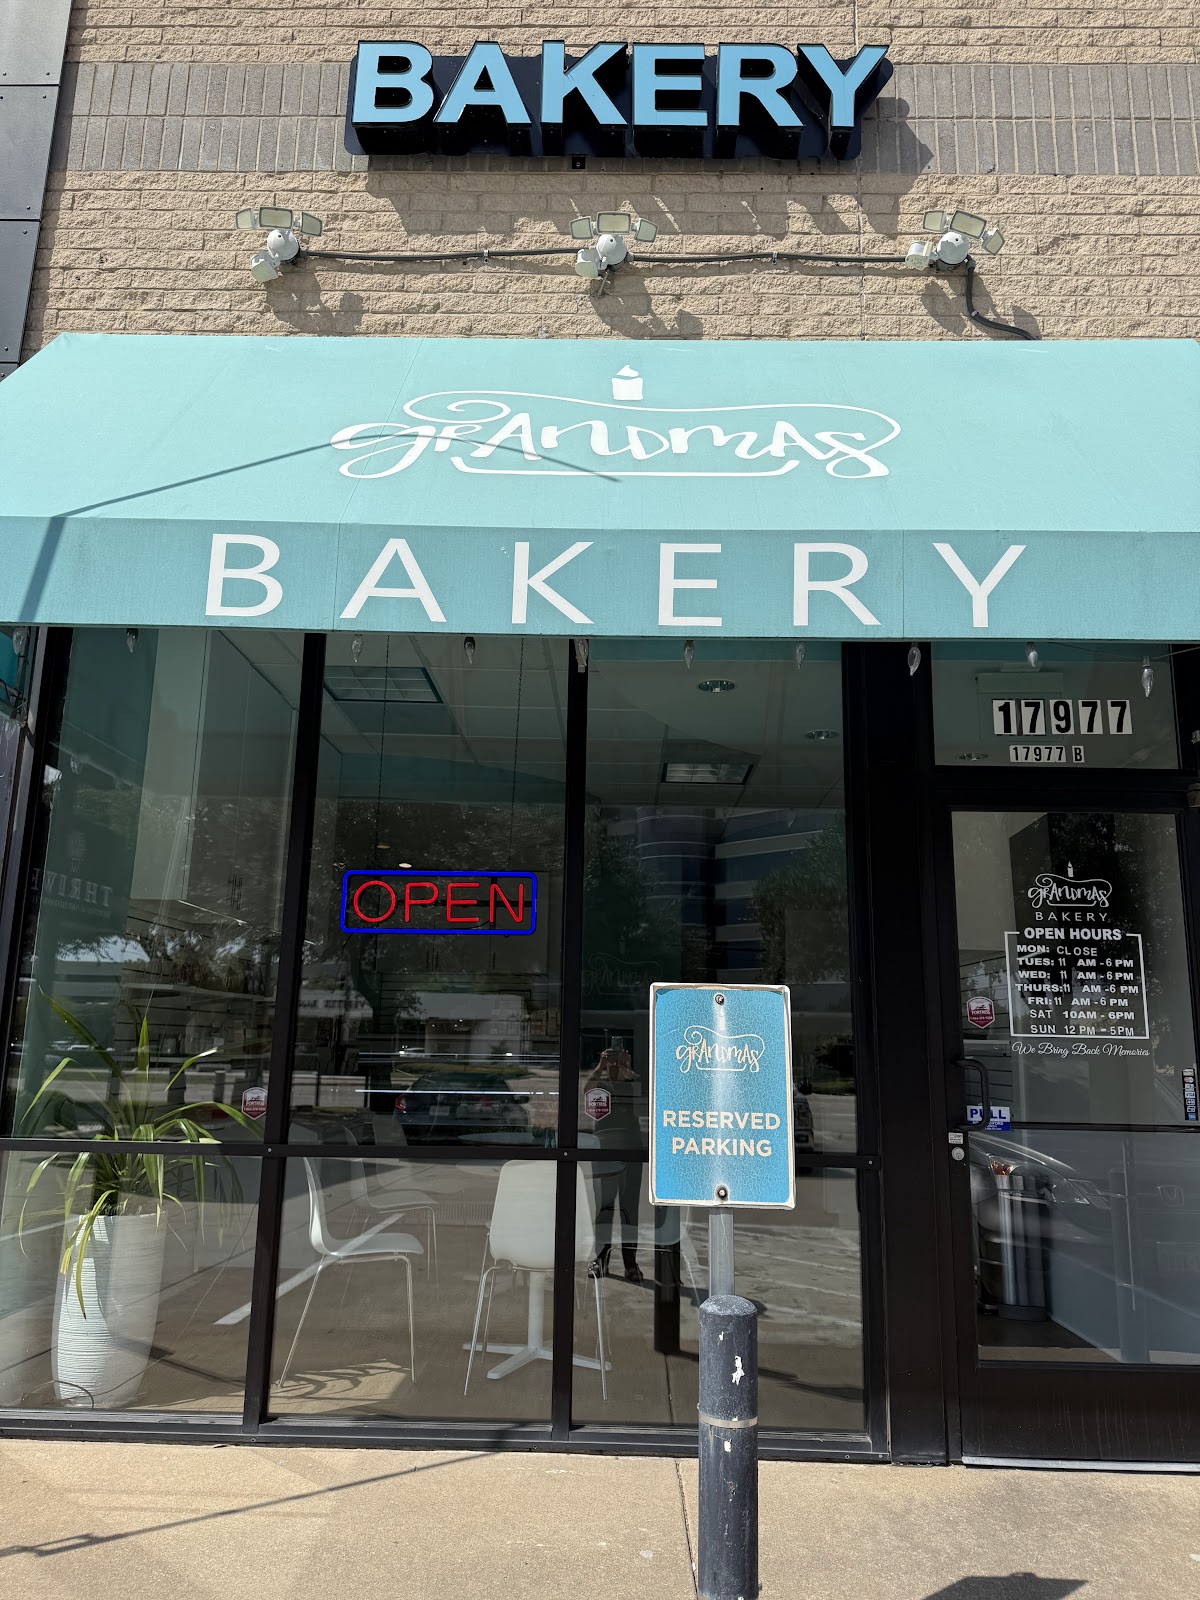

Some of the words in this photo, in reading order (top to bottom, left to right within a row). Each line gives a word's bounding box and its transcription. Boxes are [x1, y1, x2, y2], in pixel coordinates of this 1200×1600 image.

[352, 41, 890, 128] BAKERY
[205, 532, 1026, 627] BAKERY
[998, 700, 1127, 734] 17977
[1013, 747, 1063, 761] 17977
[1074, 747, 1083, 762] B
[353, 880, 524, 923] OPEN
[1035, 911, 1108, 922] BAKERY
[1024, 927, 1065, 940] OPEN
[1069, 928, 1122, 941] HOURS
[1016, 945, 1050, 953] MON:
[1056, 946, 1098, 956] CLOSE
[1016, 958, 1054, 966] TUES:
[1058, 958, 1066, 966] 11
[1077, 959, 1096, 967] AM
[1106, 958, 1112, 967] 6
[1115, 960, 1134, 968] PM
[1018, 971, 1050, 979] WED:
[1060, 971, 1067, 979] 11
[1077, 972, 1096, 980] AM
[1106, 971, 1113, 980] 6
[1115, 972, 1134, 980] PM
[1082, 985, 1101, 993] AM
[1120, 985, 1139, 994] PM
[1027, 997, 1052, 1005] FRI:
[1071, 998, 1091, 1006] AM
[1109, 998, 1129, 1007] PM
[1030, 1010, 1052, 1019] SAT
[1062, 1011, 1097, 1019] 10AM
[1108, 1011, 1135, 1020] 6PM
[1030, 1025, 1056, 1034] SUN
[1012, 1041, 1036, 1055] We
[1038, 1042, 1069, 1058] Bring
[1072, 1042, 1100, 1056] Back
[1102, 1043, 1150, 1056] Memories
[663, 1110, 780, 1130] RESERVED
[672, 1137, 772, 1157] PARKING
